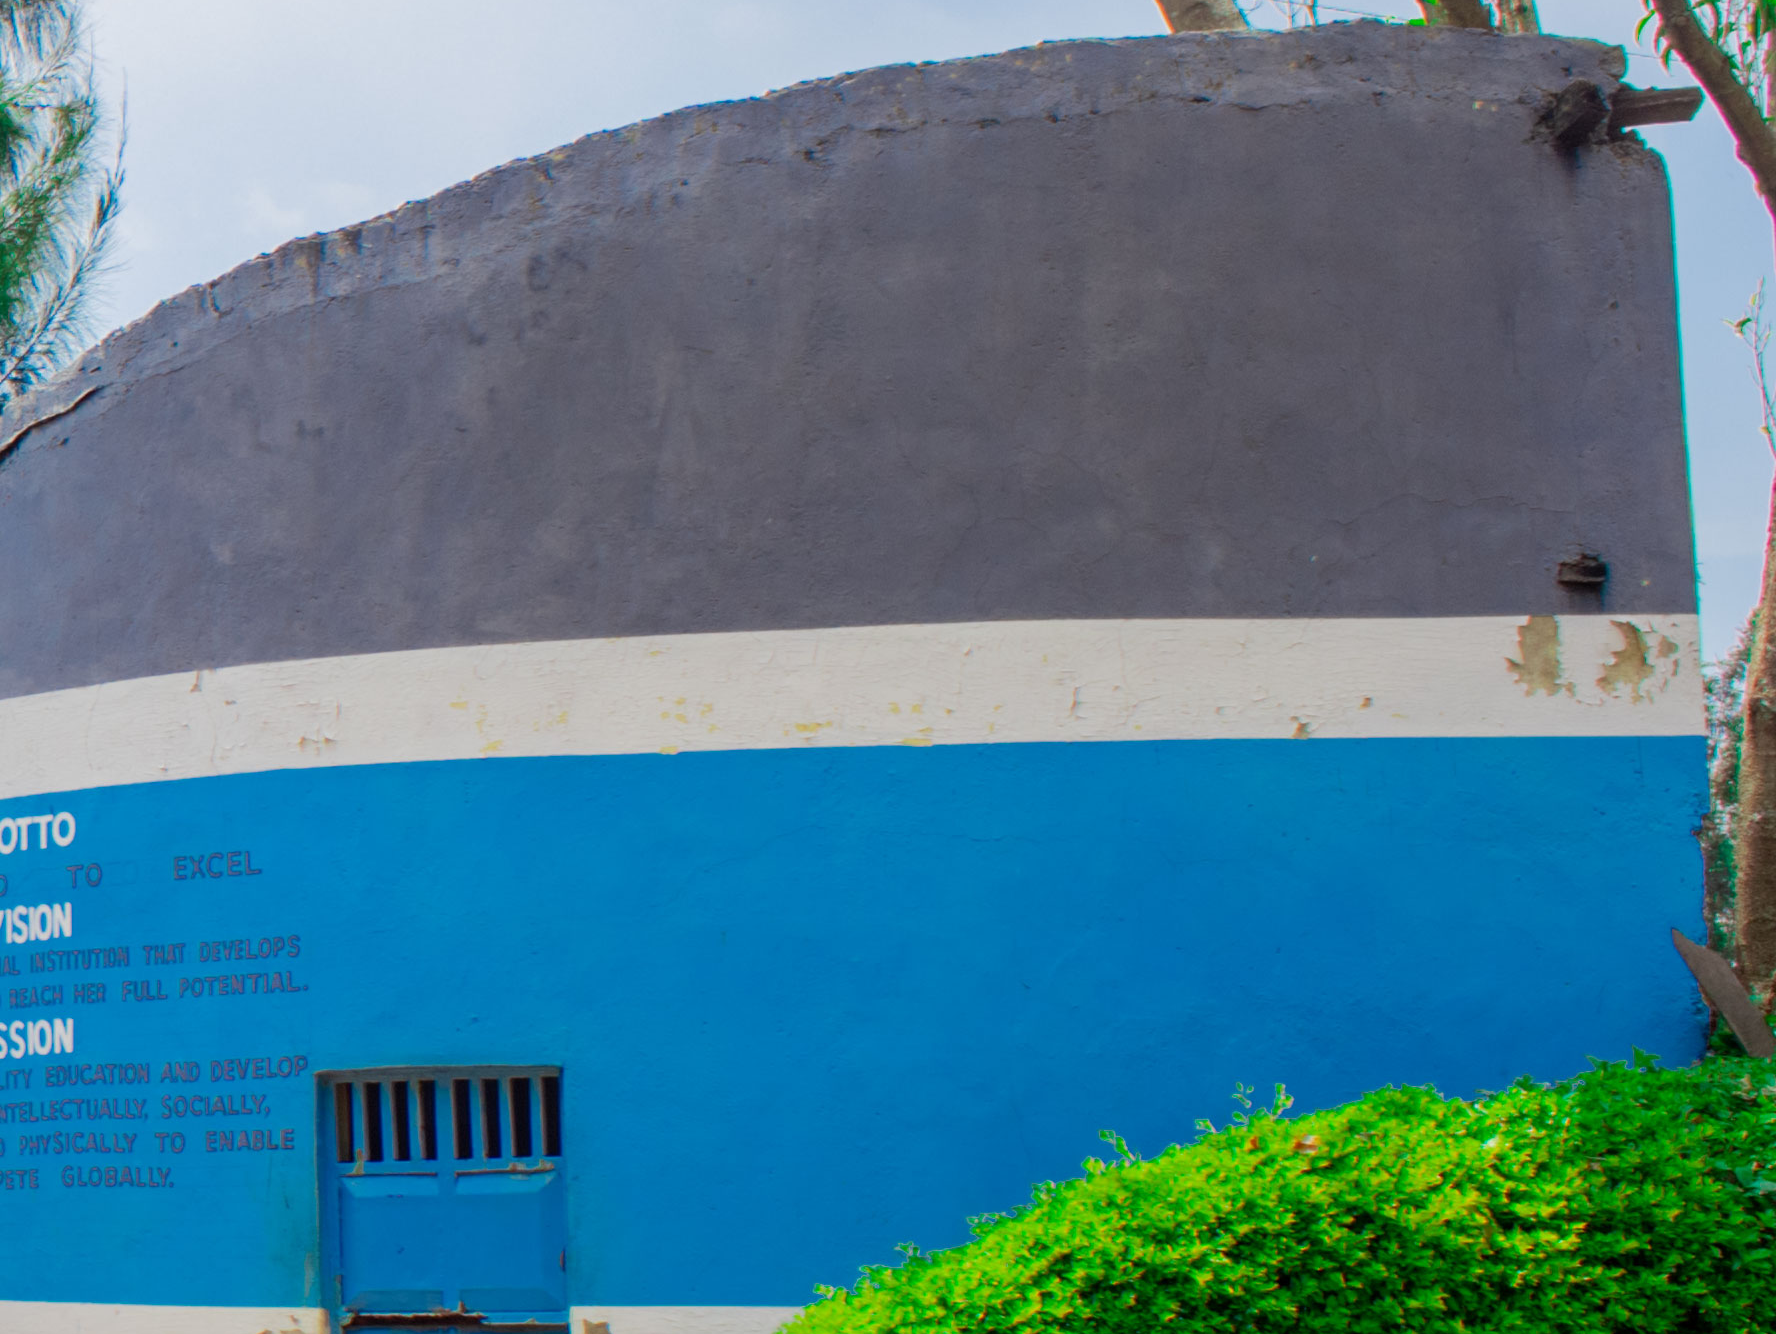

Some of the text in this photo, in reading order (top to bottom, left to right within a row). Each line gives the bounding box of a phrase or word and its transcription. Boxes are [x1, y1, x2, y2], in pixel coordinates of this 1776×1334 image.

[67, 863, 104, 890] TO
[173, 851, 262, 880] EXCEL
[30, 946, 129, 973] INSTITUTION
[143, 943, 186, 966] THAT
[199, 934, 301, 963] DEVELOPS
[9, 984, 63, 1009] REACH
[73, 982, 106, 1004] HER
[121, 979, 168, 1002] FULL
[179, 971, 309, 998] POTENTIAL.
[45, 1062, 150, 1088] EDUCATION
[160, 1061, 200, 1084] AND
[210, 1055, 309, 1082] DEVELOP
[161, 1094, 271, 1119] SOCIALLY,
[19, 1131, 137, 1156] PHYSICALLY
[155, 1132, 185, 1153] TO
[205, 1128, 295, 1152] ENABLE
[61, 1165, 174, 1188] GLOBALLY.
